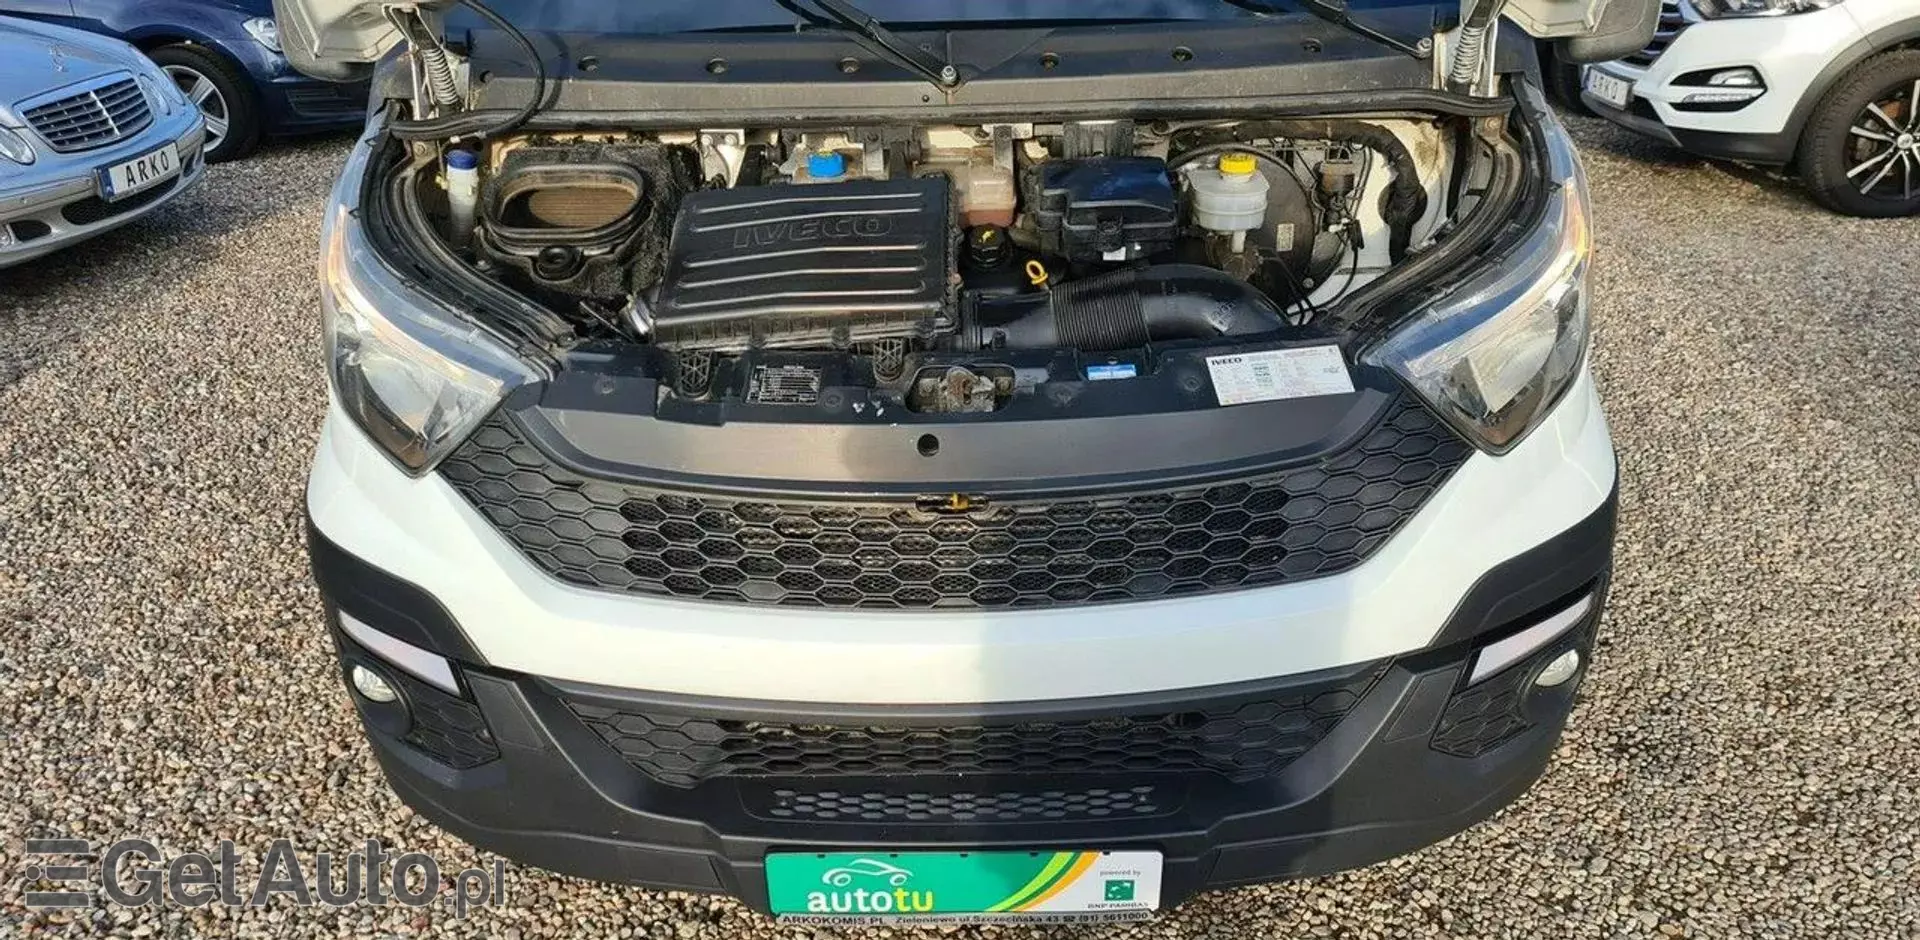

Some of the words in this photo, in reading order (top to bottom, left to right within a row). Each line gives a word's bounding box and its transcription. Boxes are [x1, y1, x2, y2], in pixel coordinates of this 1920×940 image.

[1592, 74, 1619, 100] ARKO
[126, 151, 169, 187] ARKO
[733, 215, 893, 249] IVECO
[1211, 357, 1242, 365] IVECO
[807, 888, 933, 912] autotu
[1103, 912, 1149, 921] 5611000
